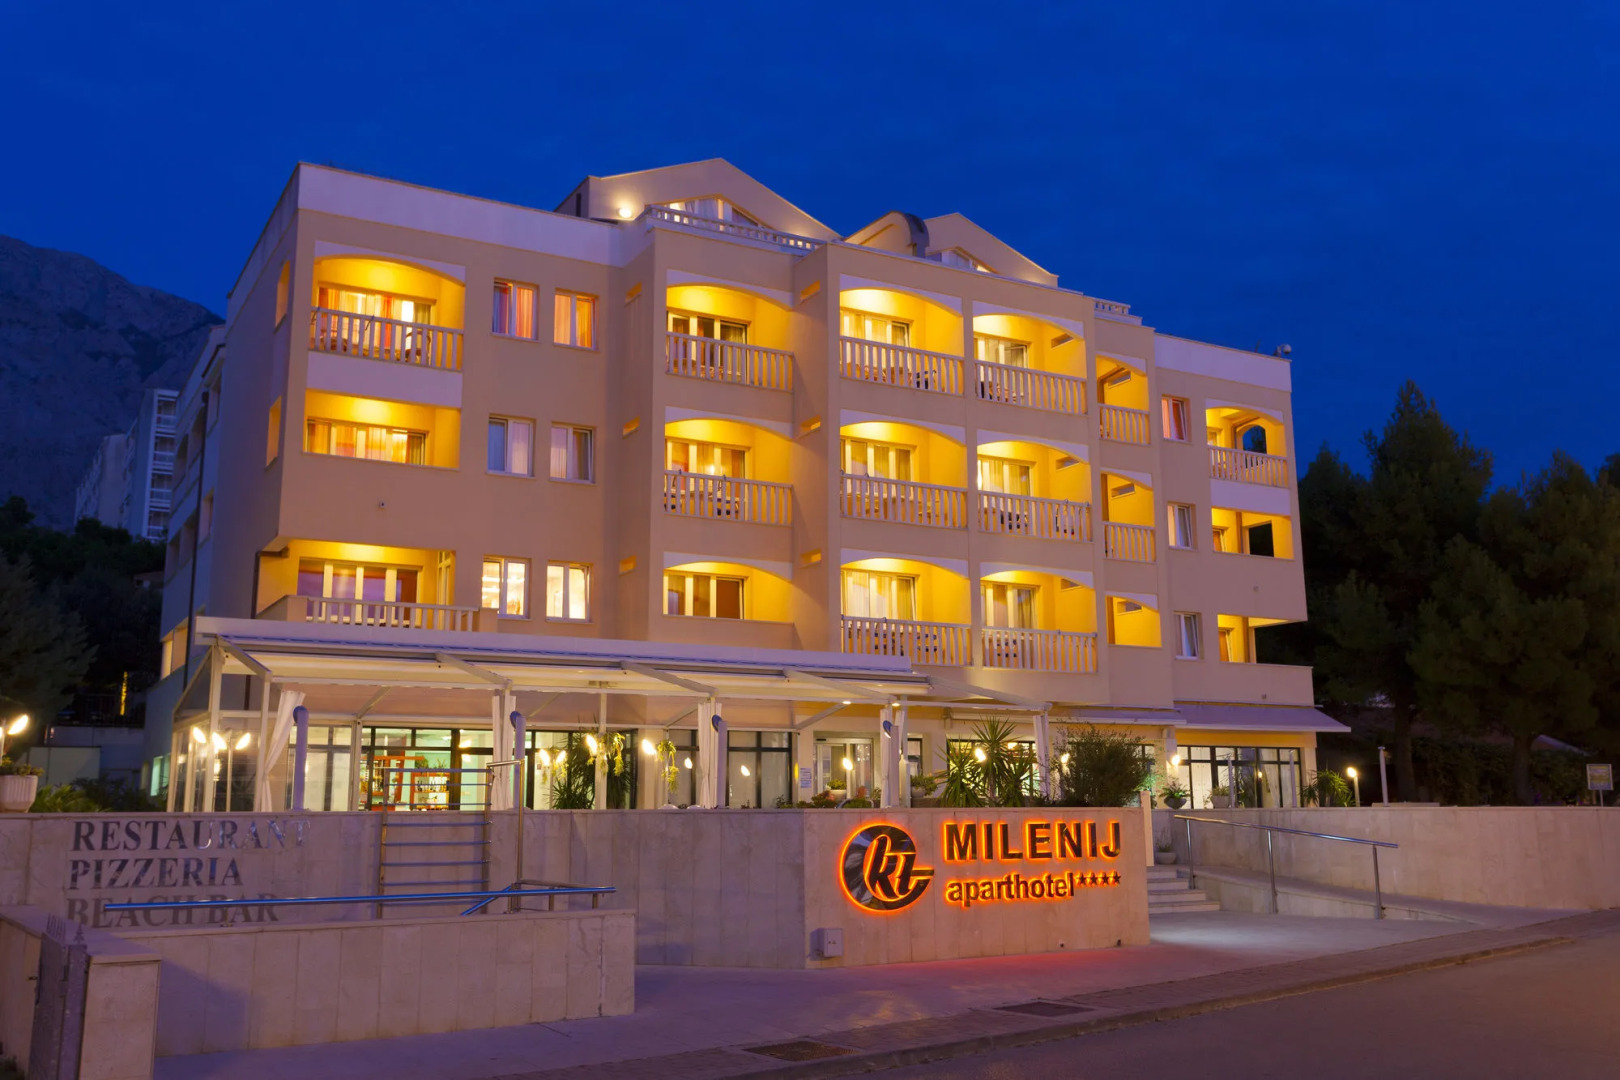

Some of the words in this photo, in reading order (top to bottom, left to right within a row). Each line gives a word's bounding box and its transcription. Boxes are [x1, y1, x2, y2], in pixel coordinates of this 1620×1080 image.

[71, 819, 311, 852] RESTAURANT
[945, 822, 1121, 861] MILENIJ
[67, 856, 244, 891] PIZZERIA
[946, 871, 1075, 908] aparthotel
[66, 894, 198, 929] BEACH
[206, 892, 280, 924] BAR
